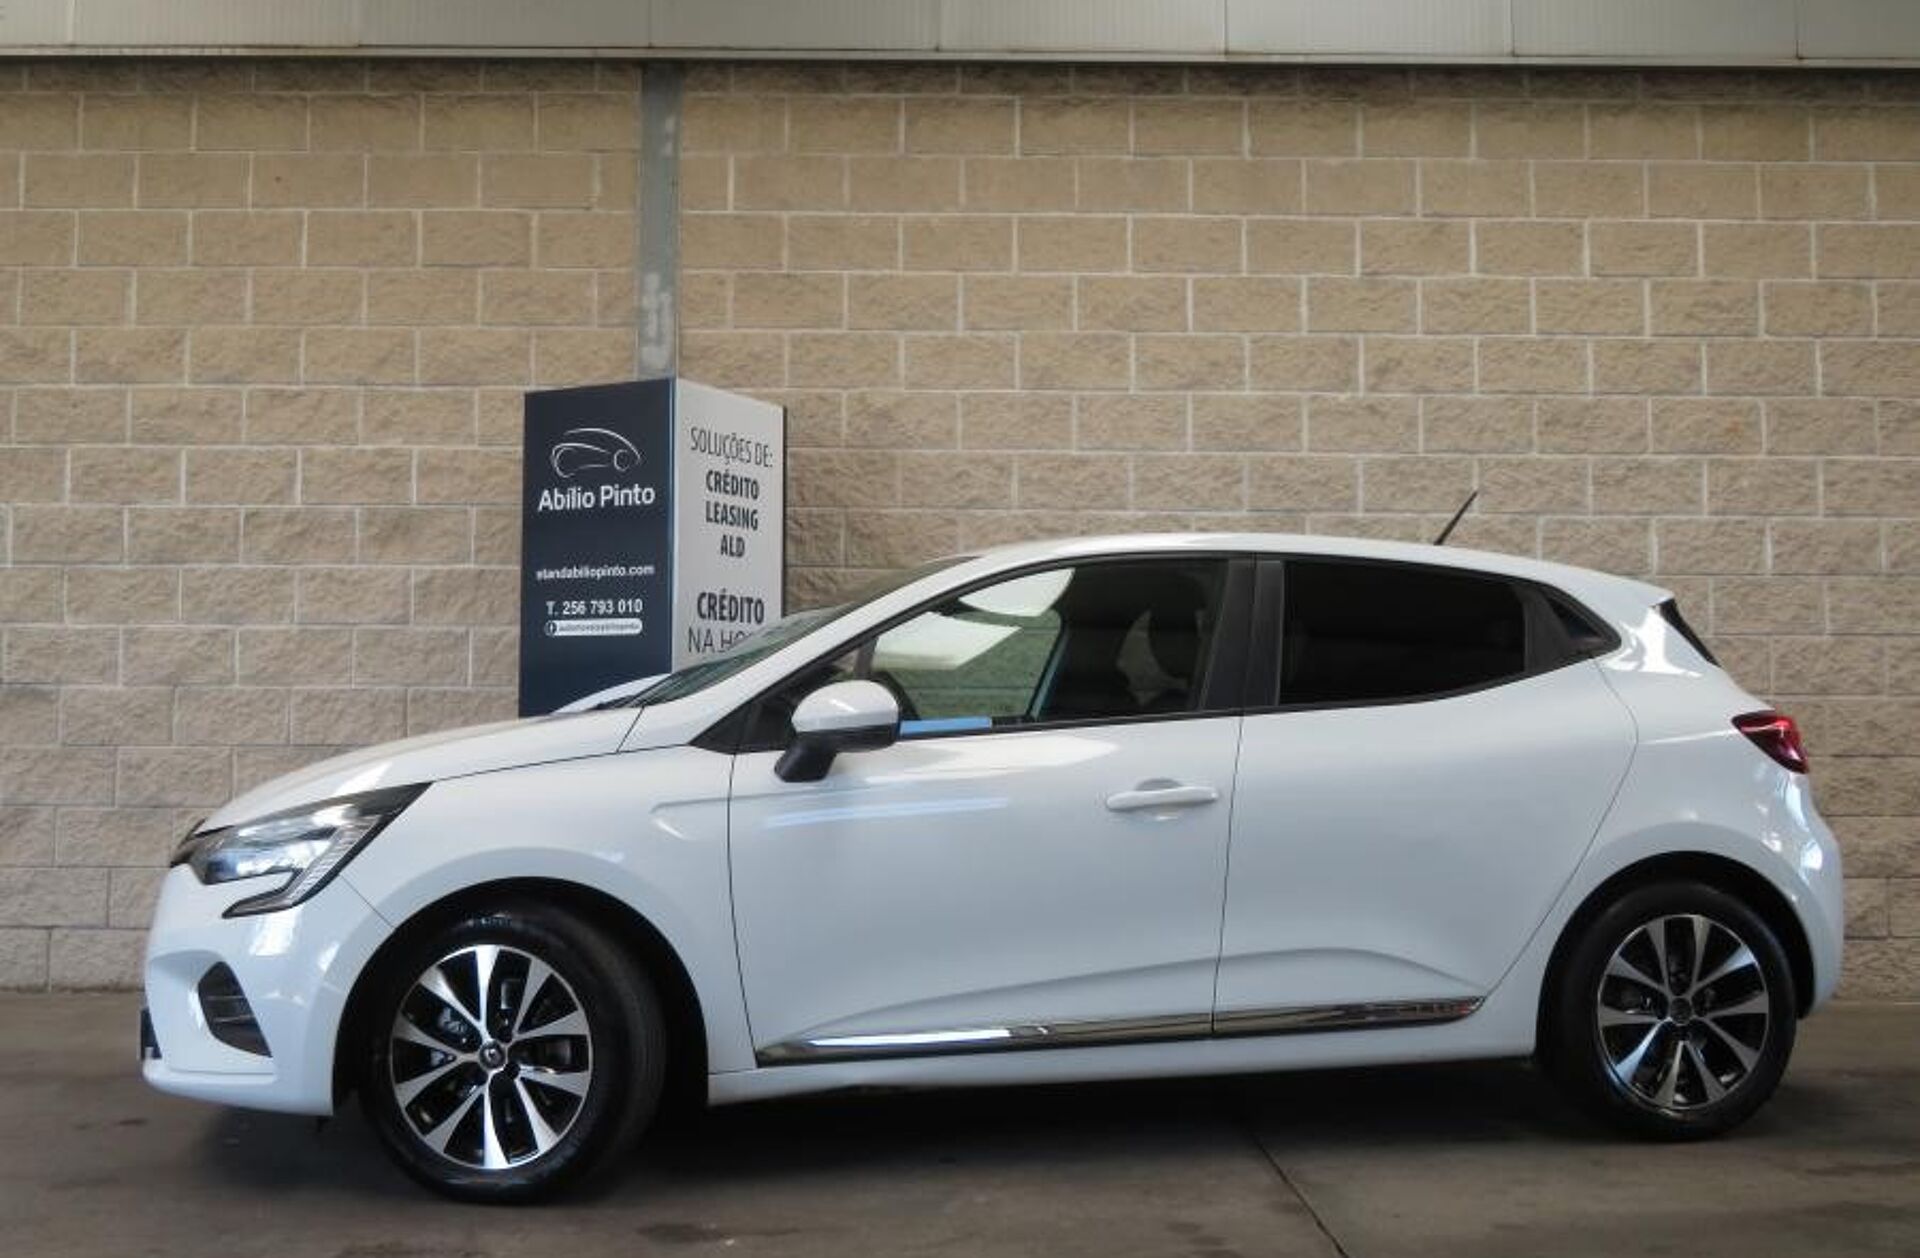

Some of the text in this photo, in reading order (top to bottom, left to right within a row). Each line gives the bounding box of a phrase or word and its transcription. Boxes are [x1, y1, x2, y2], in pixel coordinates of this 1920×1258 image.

[691, 426, 773, 468] SOLUÇÕES DE:
[538, 483, 655, 511] Abílio Pinto
[706, 469, 759, 499] CRÉDITO
[706, 501, 758, 531] LEASING
[720, 534, 745, 557] ALD
[545, 598, 643, 615] T. 256 793 010
[697, 587, 764, 625] CRÉDITO
[688, 626, 715, 653] NA
